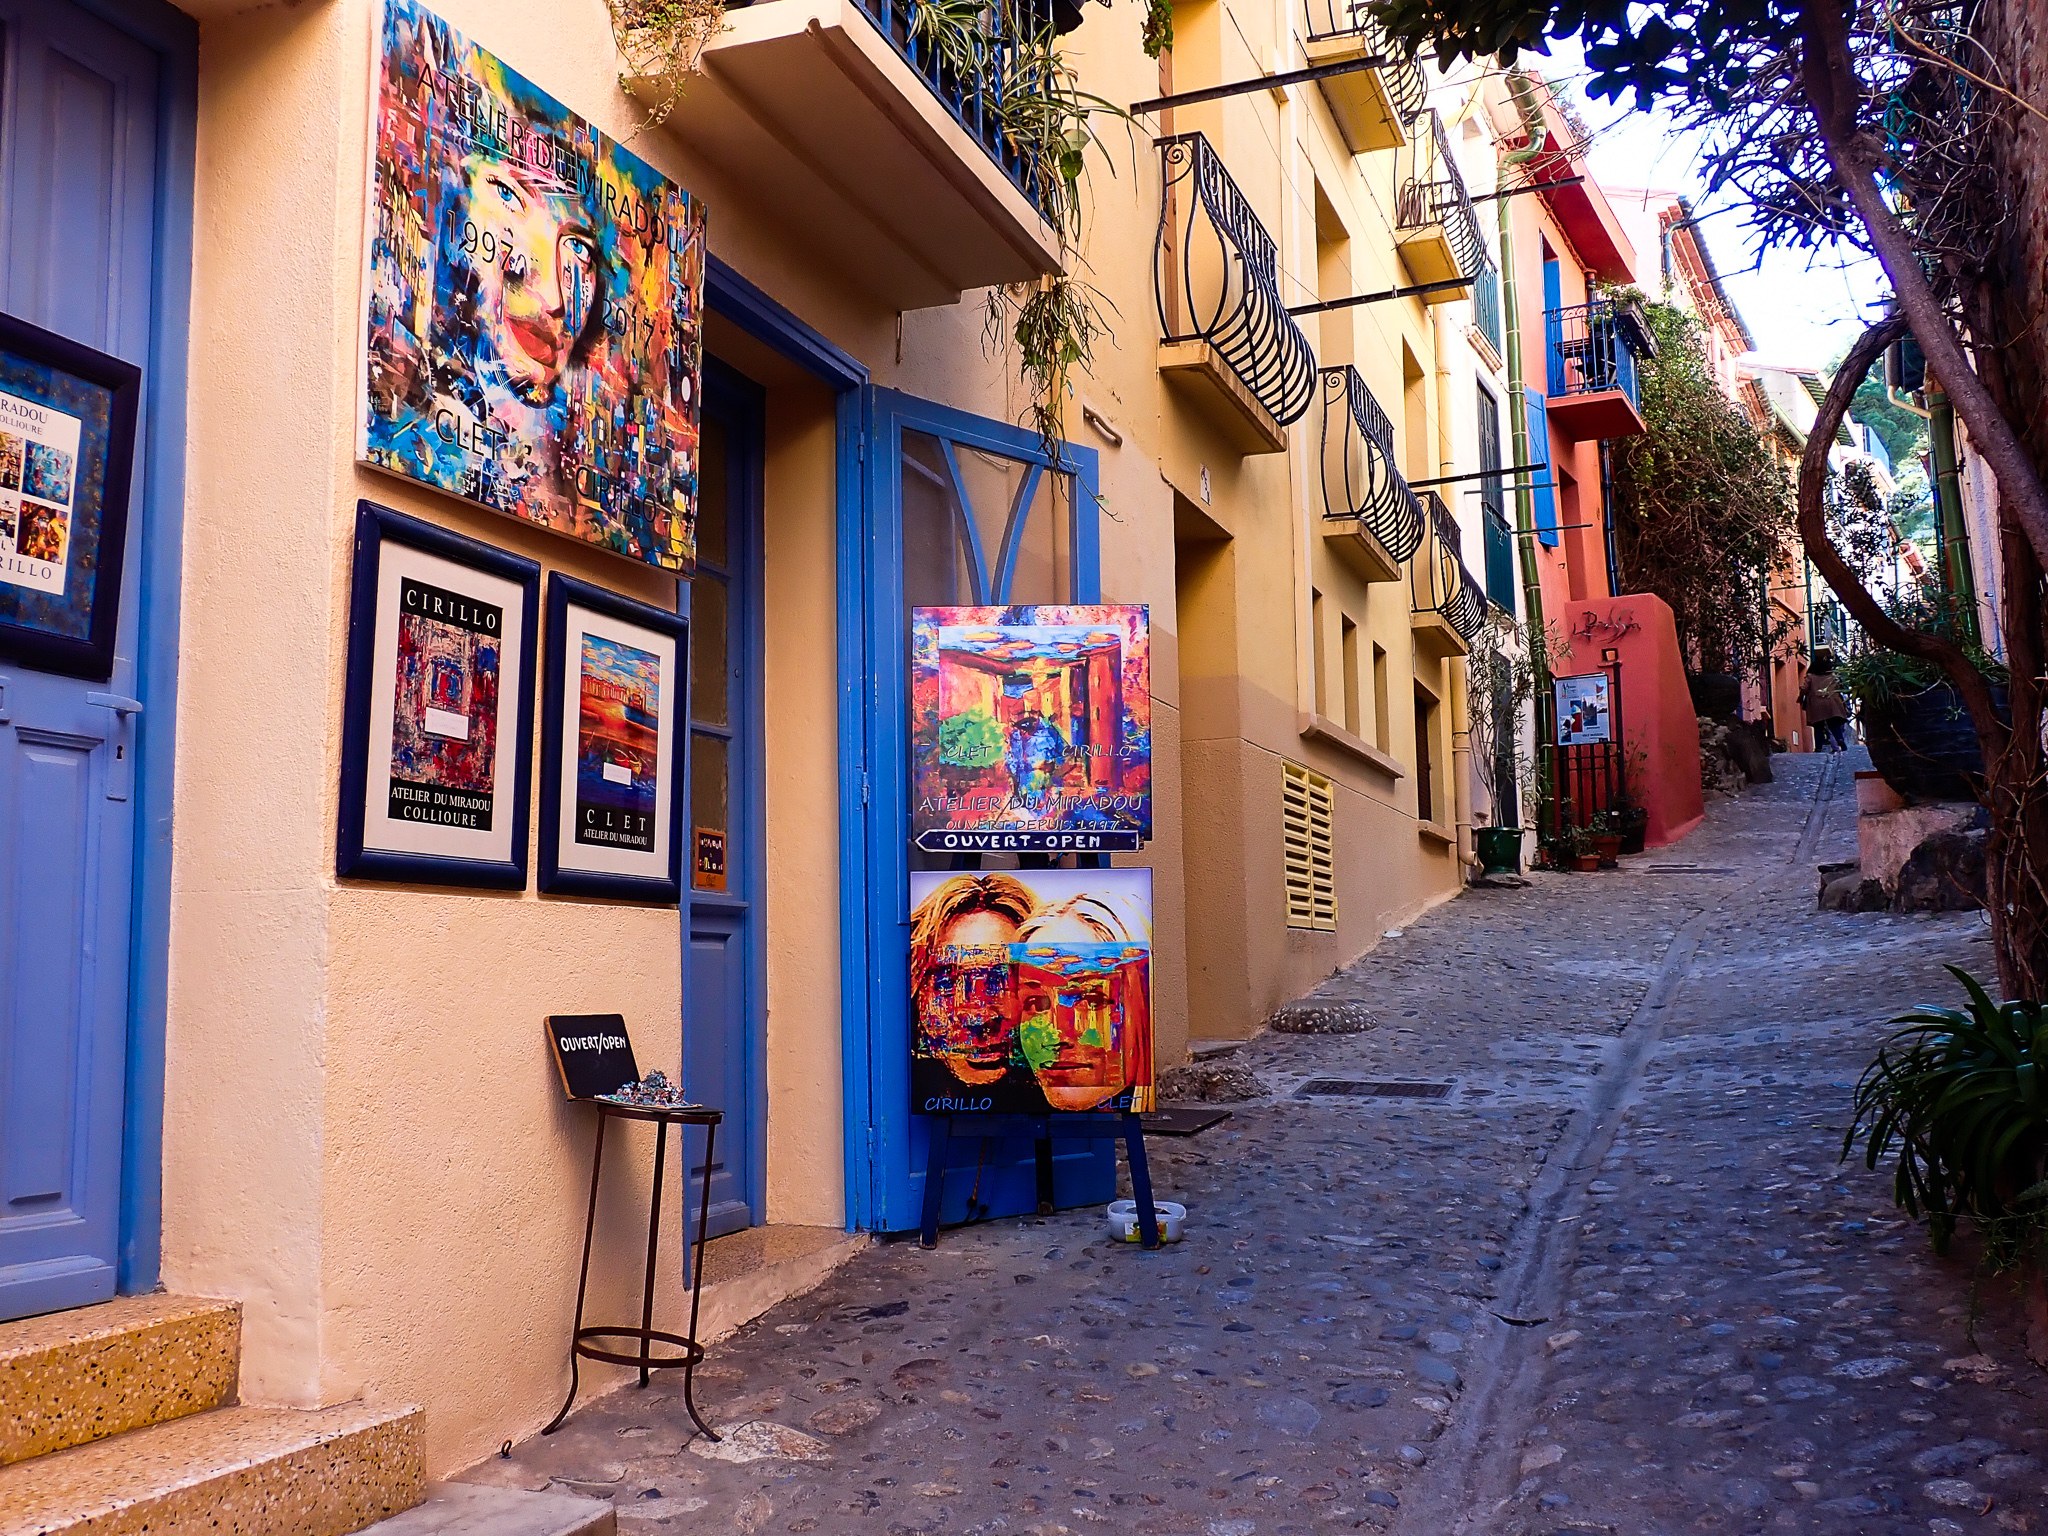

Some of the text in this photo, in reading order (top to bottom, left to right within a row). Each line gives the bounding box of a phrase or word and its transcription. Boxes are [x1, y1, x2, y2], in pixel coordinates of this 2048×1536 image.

[416, 63, 680, 254] ATELIER DU MIRADOU
[447, 210, 514, 271] 1997
[435, 408, 504, 461] CLET
[575, 467, 657, 523] CIRILLO
[406, 589, 496, 629] CIRILLO
[946, 745, 992, 758] CLET
[1062, 744, 1132, 758] CIRILLO
[391, 786, 491, 812] ATELIER DU MIRADOU
[919, 795, 1142, 812] ATELIER DU MIRADOU
[403, 805, 477, 827] COLLIOURE
[586, 808, 647, 831] CLET
[946, 820, 1009, 830] OUVERT
[1014, 820, 1072, 830] DEPUIS
[583, 828, 648, 846] ATELIER DU MIRADOU
[924, 1097, 992, 1111] CIRILLO
[1096, 1095, 1143, 1110] CLET
